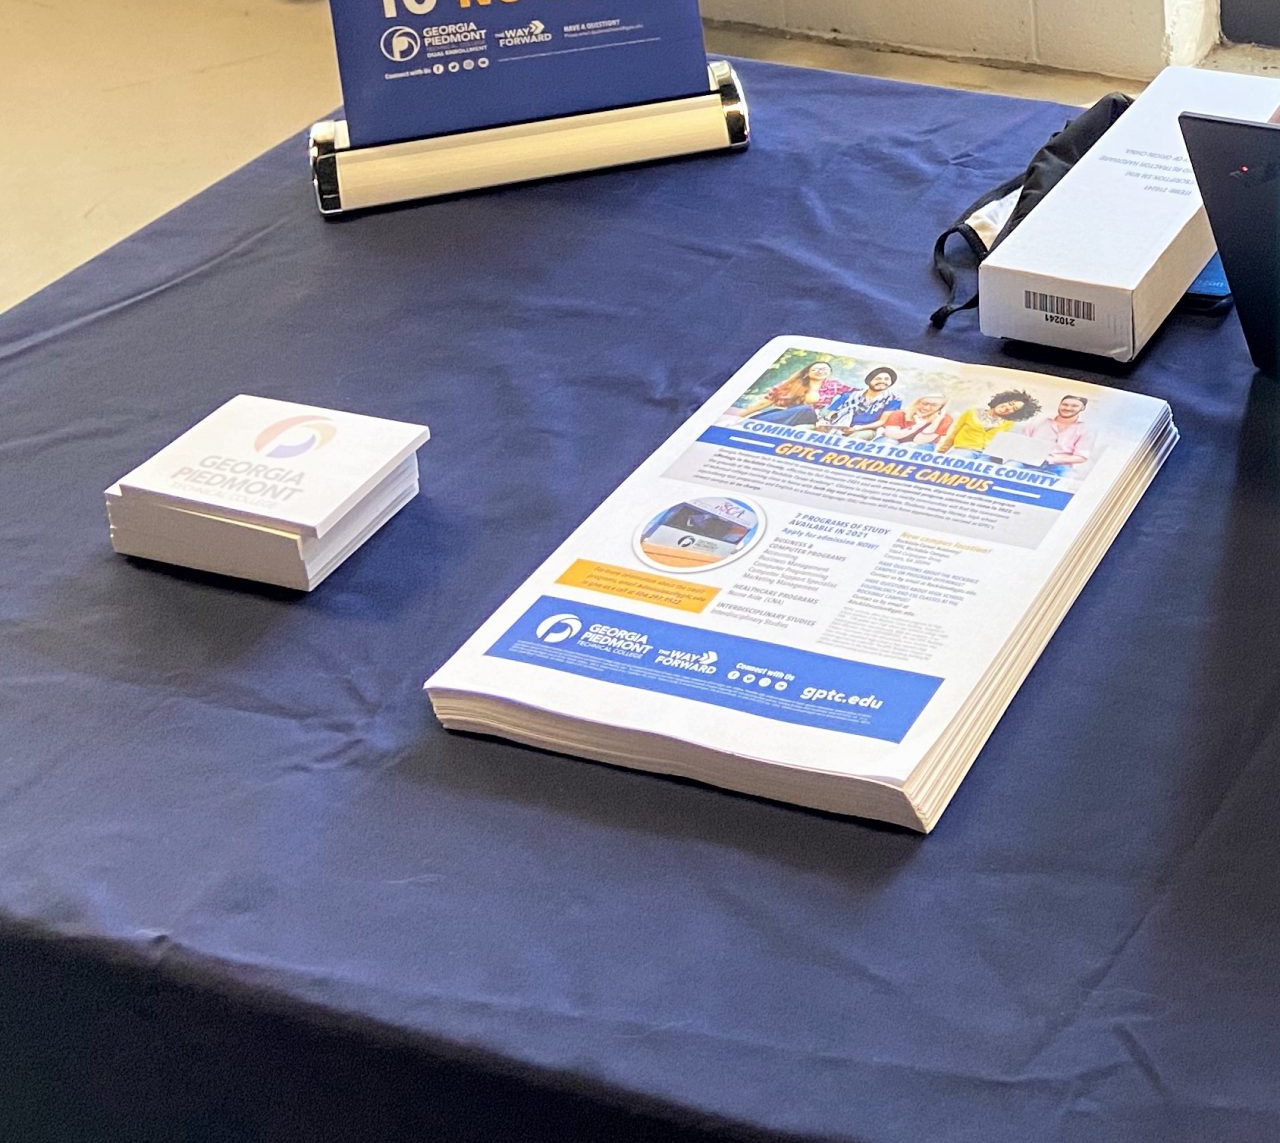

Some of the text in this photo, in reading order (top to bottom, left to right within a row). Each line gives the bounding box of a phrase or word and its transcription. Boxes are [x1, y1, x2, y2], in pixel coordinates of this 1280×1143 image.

[423, 22, 477, 36] GEORGIA
[424, 30, 486, 46] PIEDMONT
[505, 27, 530, 38] WAY
[499, 33, 552, 47] FORWARD
[1044, 314, 1076, 327] 210241
[742, 420, 1061, 487] COMING FALL 2021 TO ROCKDALE COUNTY
[199, 455, 306, 486] GEORGIA
[775, 443, 818, 460] GPTC
[821, 450, 913, 481] ROCKDALE
[914, 467, 994, 493] CAMPUS
[170, 467, 304, 501] PIEDMONT
[788, 519, 834, 532] AVAILABLE
[846, 529, 868, 538] 2021
[802, 514, 848, 528] PROGRAMS
[864, 524, 891, 535] STUDY
[773, 537, 808, 547] BUSINESS
[781, 528, 804, 537] Apply
[805, 530, 816, 539] for
[817, 534, 855, 546] admission
[768, 543, 846, 562] COMPUTER PROGRAMS
[734, 583, 820, 605] HEALTHCARE PROGRAMS
[717, 602, 817, 626] INTERDISCIPLINARY STUDIES
[581, 631, 653, 655] PIEDMONT
[588, 623, 648, 645] GEORGIA
[576, 639, 612, 655] TECHNICAL
[611, 646, 644, 660] COLLEGE
[670, 650, 701, 664] WAY
[654, 655, 717, 675] FORWARD
[735, 662, 795, 681] Connect with Us
[800, 685, 883, 710] gptc.edu
